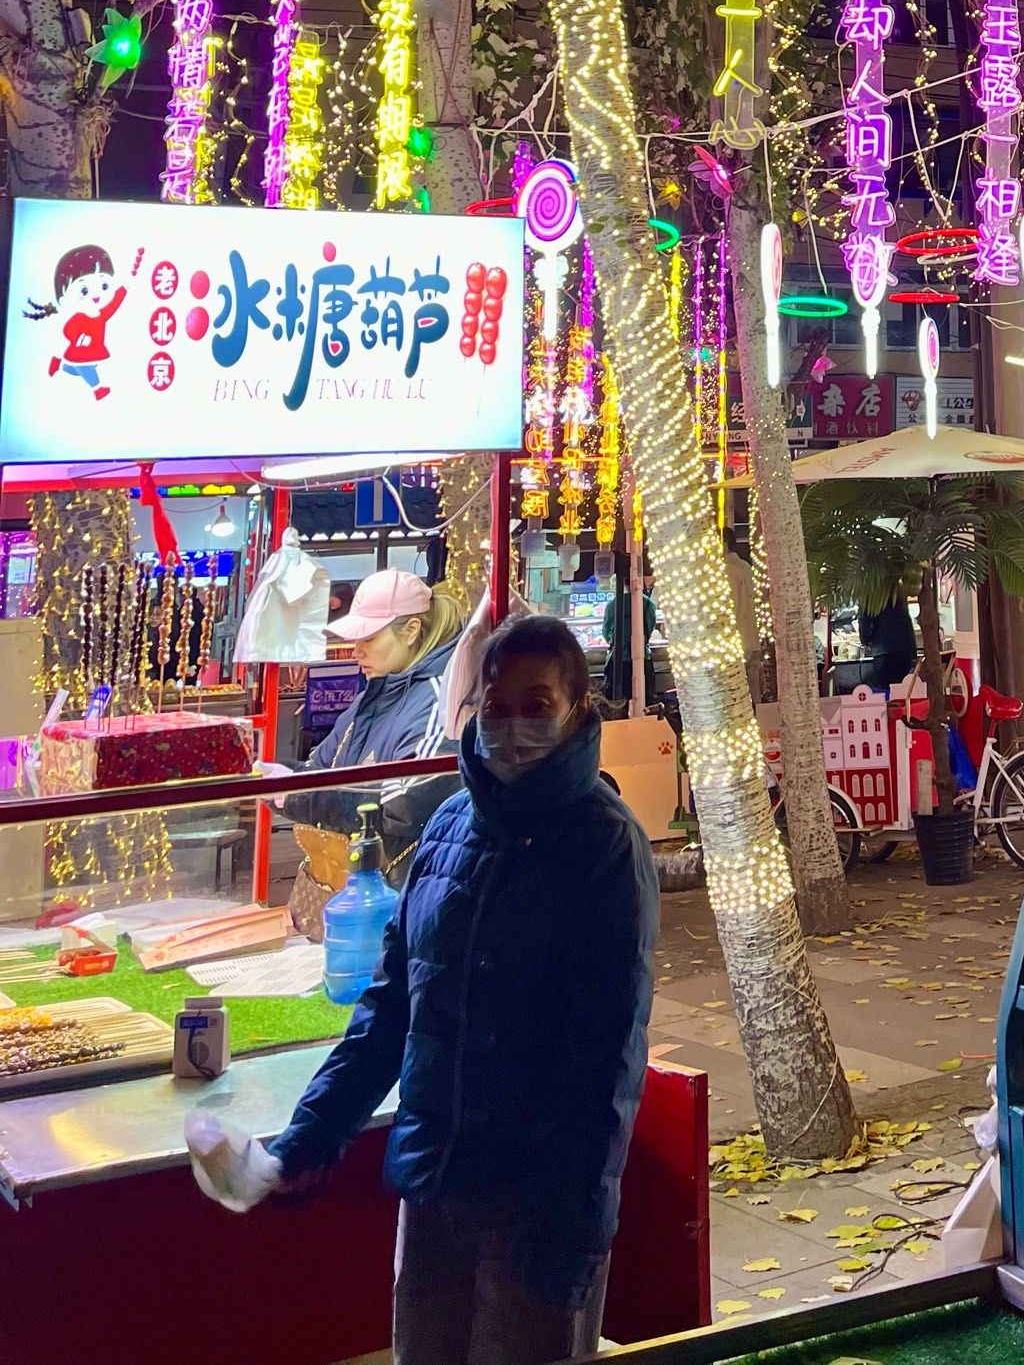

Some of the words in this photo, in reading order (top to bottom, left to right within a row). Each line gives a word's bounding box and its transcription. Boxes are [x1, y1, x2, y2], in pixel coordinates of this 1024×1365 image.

[150, 265, 178, 388] 老北京
[186, 242, 450, 411] 冰糖葫芦
[213, 379, 270, 401] BING
[317, 379, 365, 400] TANG
[372, 379, 398, 400] HU
[406, 379, 431, 399] LU
